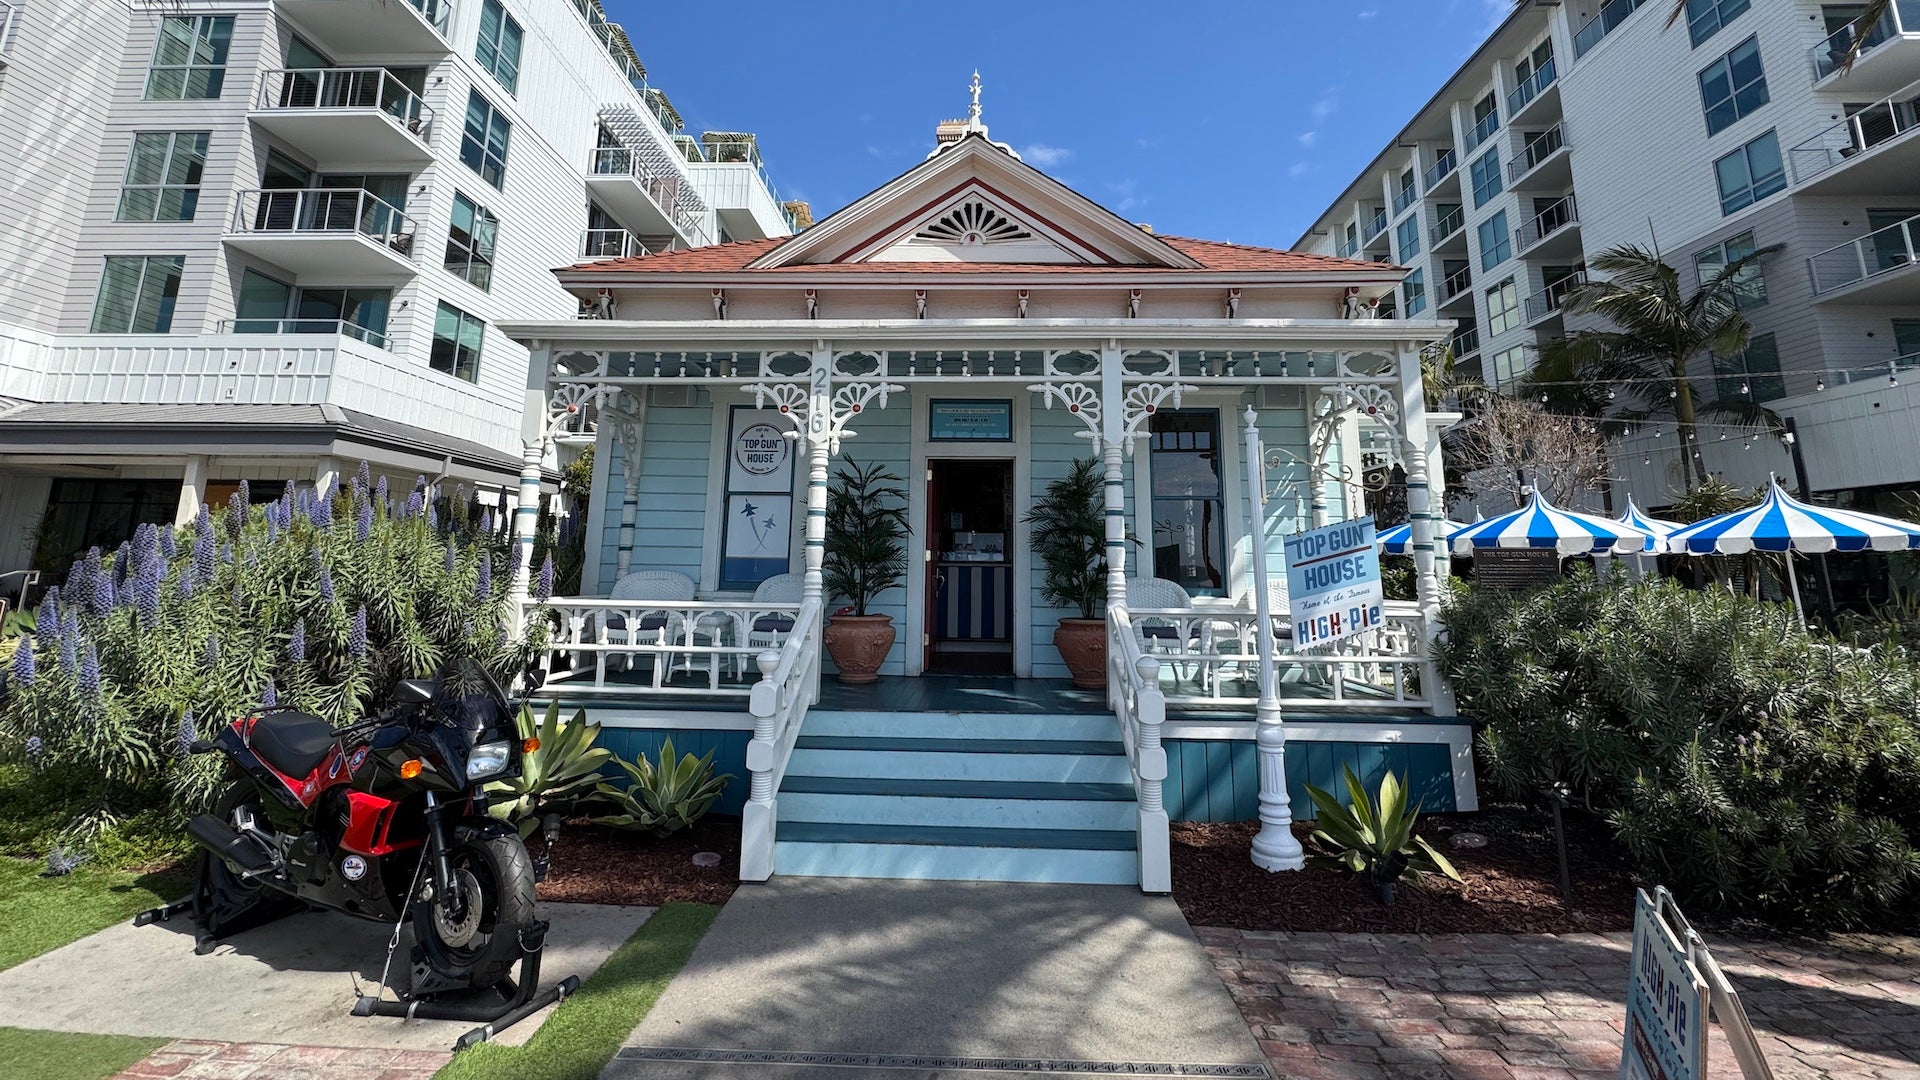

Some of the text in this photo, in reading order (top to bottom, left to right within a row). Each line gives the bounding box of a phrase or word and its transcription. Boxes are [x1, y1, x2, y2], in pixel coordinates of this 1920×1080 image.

[811, 367, 827, 434] 216
[742, 439, 782, 450] TOP GUN
[747, 453, 774, 463] HOUSE
[1286, 523, 1372, 559] TOP GUN
[1304, 555, 1367, 591] HOUSE
[1300, 600, 1321, 610] Home
[1333, 592, 1344, 602] the
